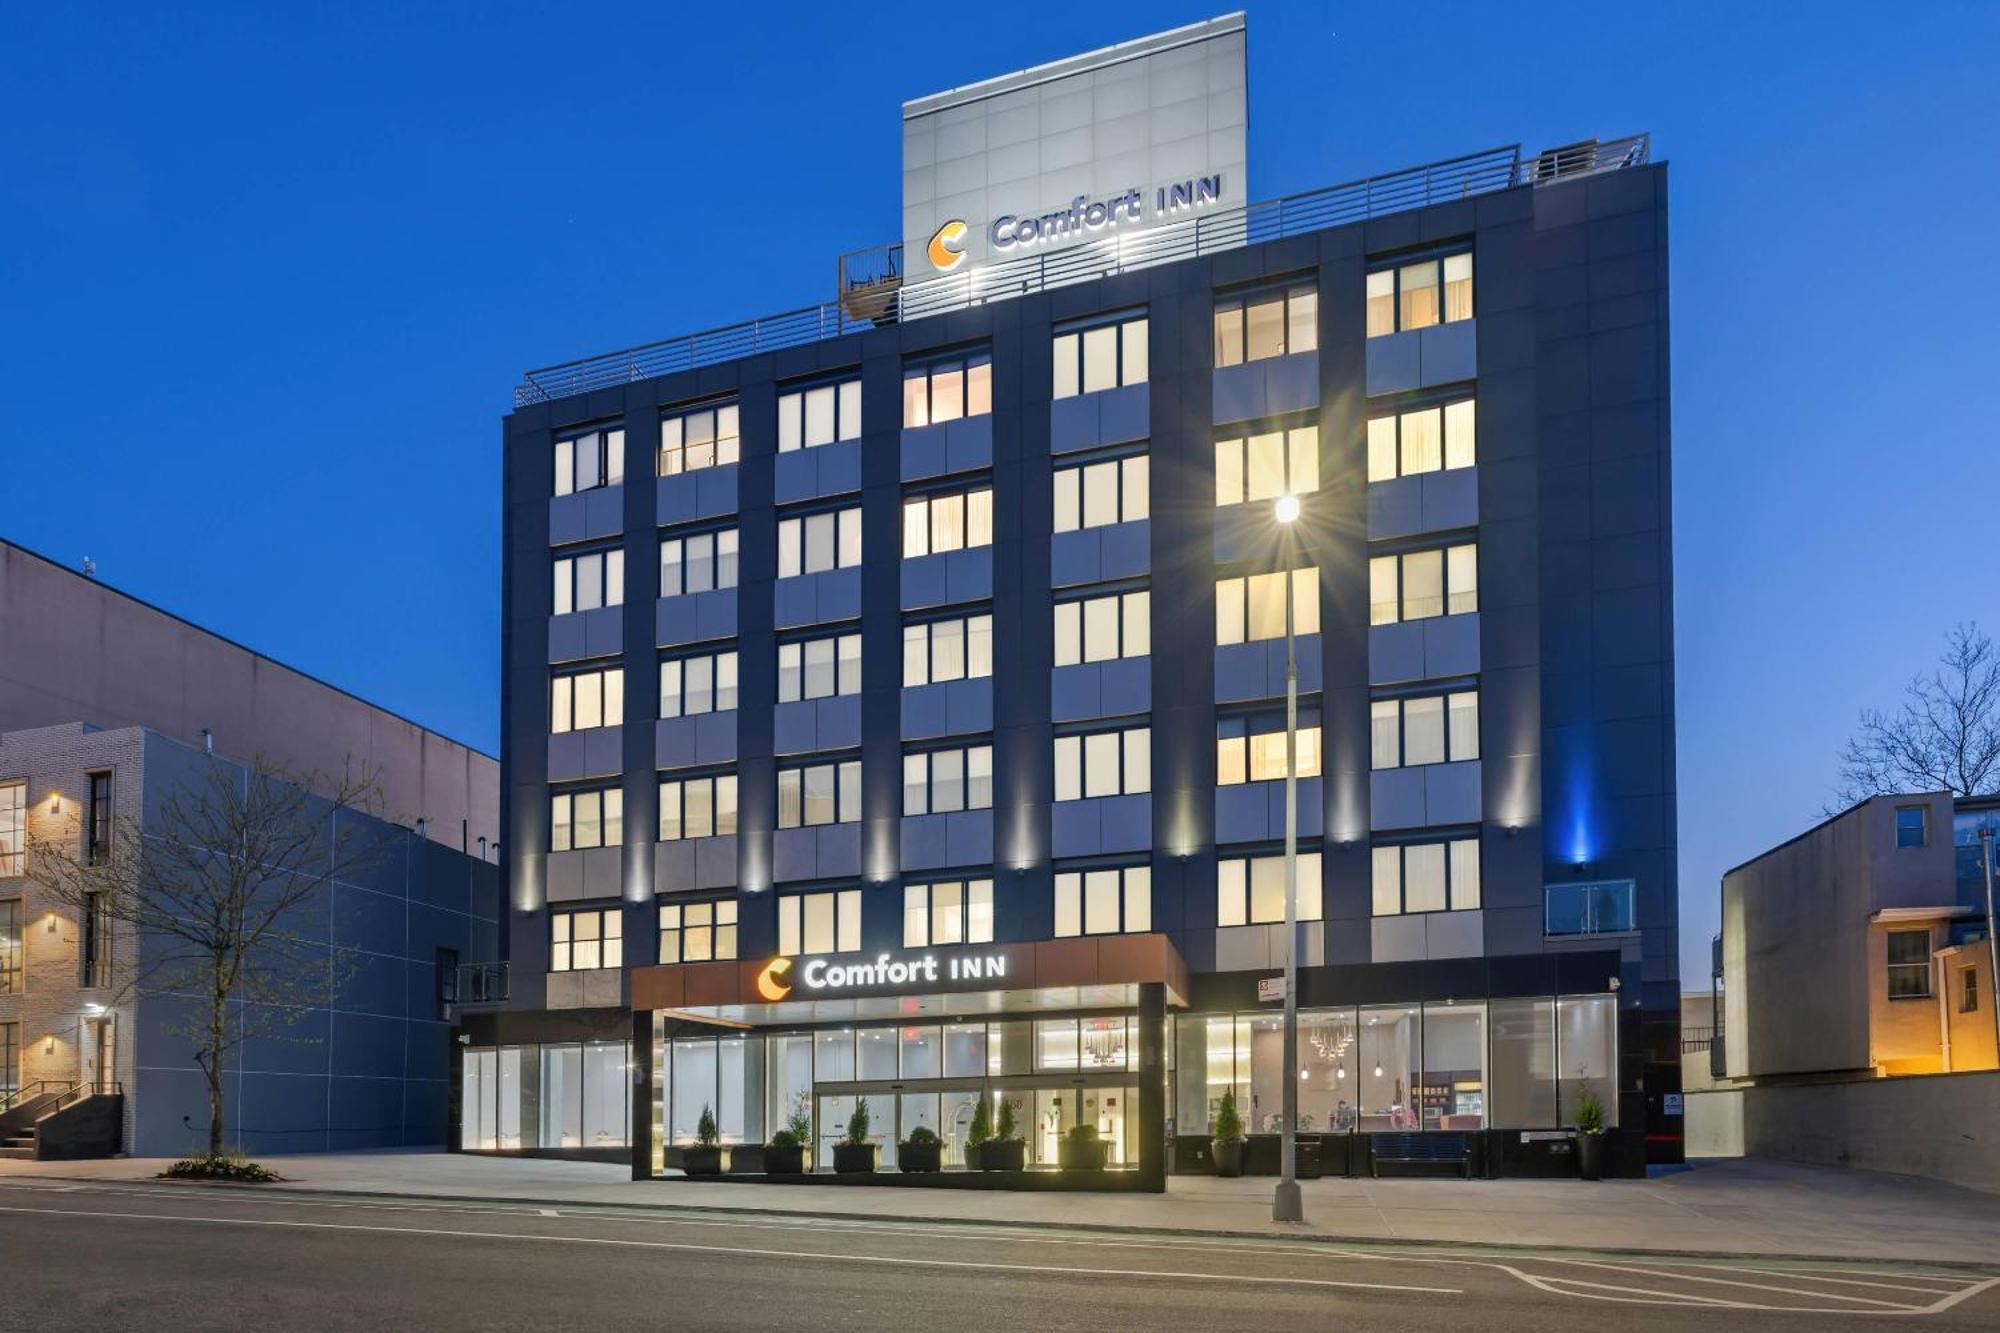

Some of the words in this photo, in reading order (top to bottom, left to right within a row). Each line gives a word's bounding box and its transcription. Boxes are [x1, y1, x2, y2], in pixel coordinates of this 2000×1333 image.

[992, 189, 1141, 249] Comfort
[1156, 174, 1220, 215] INN
[804, 953, 938, 988] Comfort
[951, 956, 1005, 979] INN
